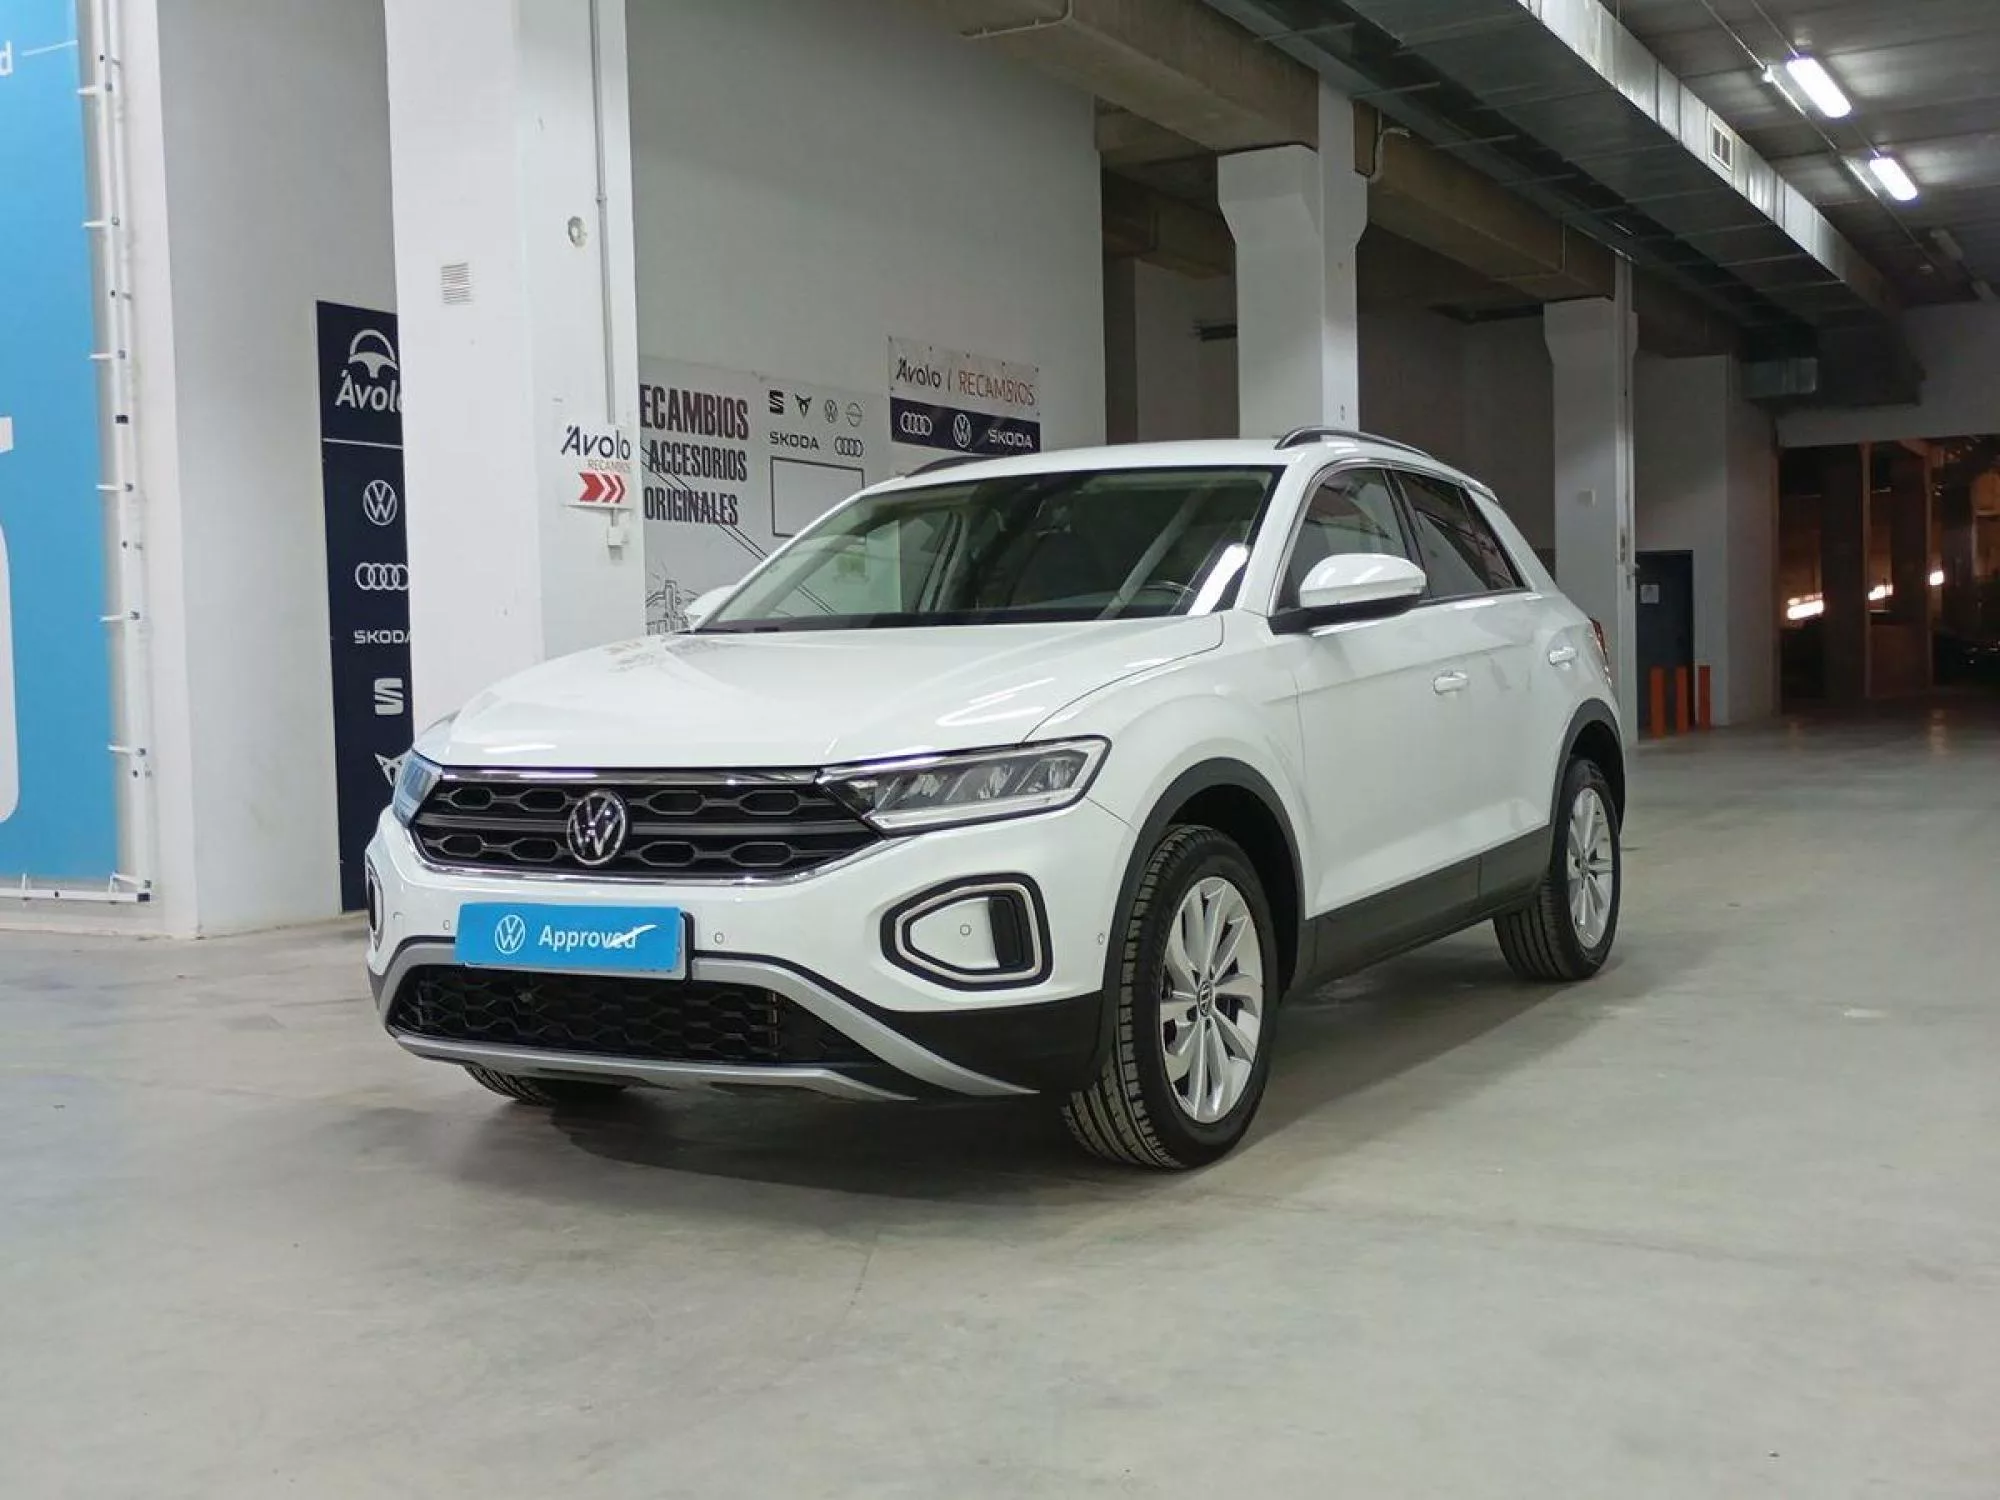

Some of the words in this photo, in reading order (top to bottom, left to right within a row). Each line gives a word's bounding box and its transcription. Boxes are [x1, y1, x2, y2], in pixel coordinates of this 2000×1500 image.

[896, 357, 942, 388] Ávolo
[958, 370, 1036, 406] RECAMBIOS
[560, 425, 631, 460] Ávolo
[769, 431, 820, 450] SKODA
[988, 428, 1033, 449] SKODA
[649, 440, 747, 482] ACCESORIOS
[644, 486, 738, 525] ORIGINALES
[538, 925, 637, 952] Approved
